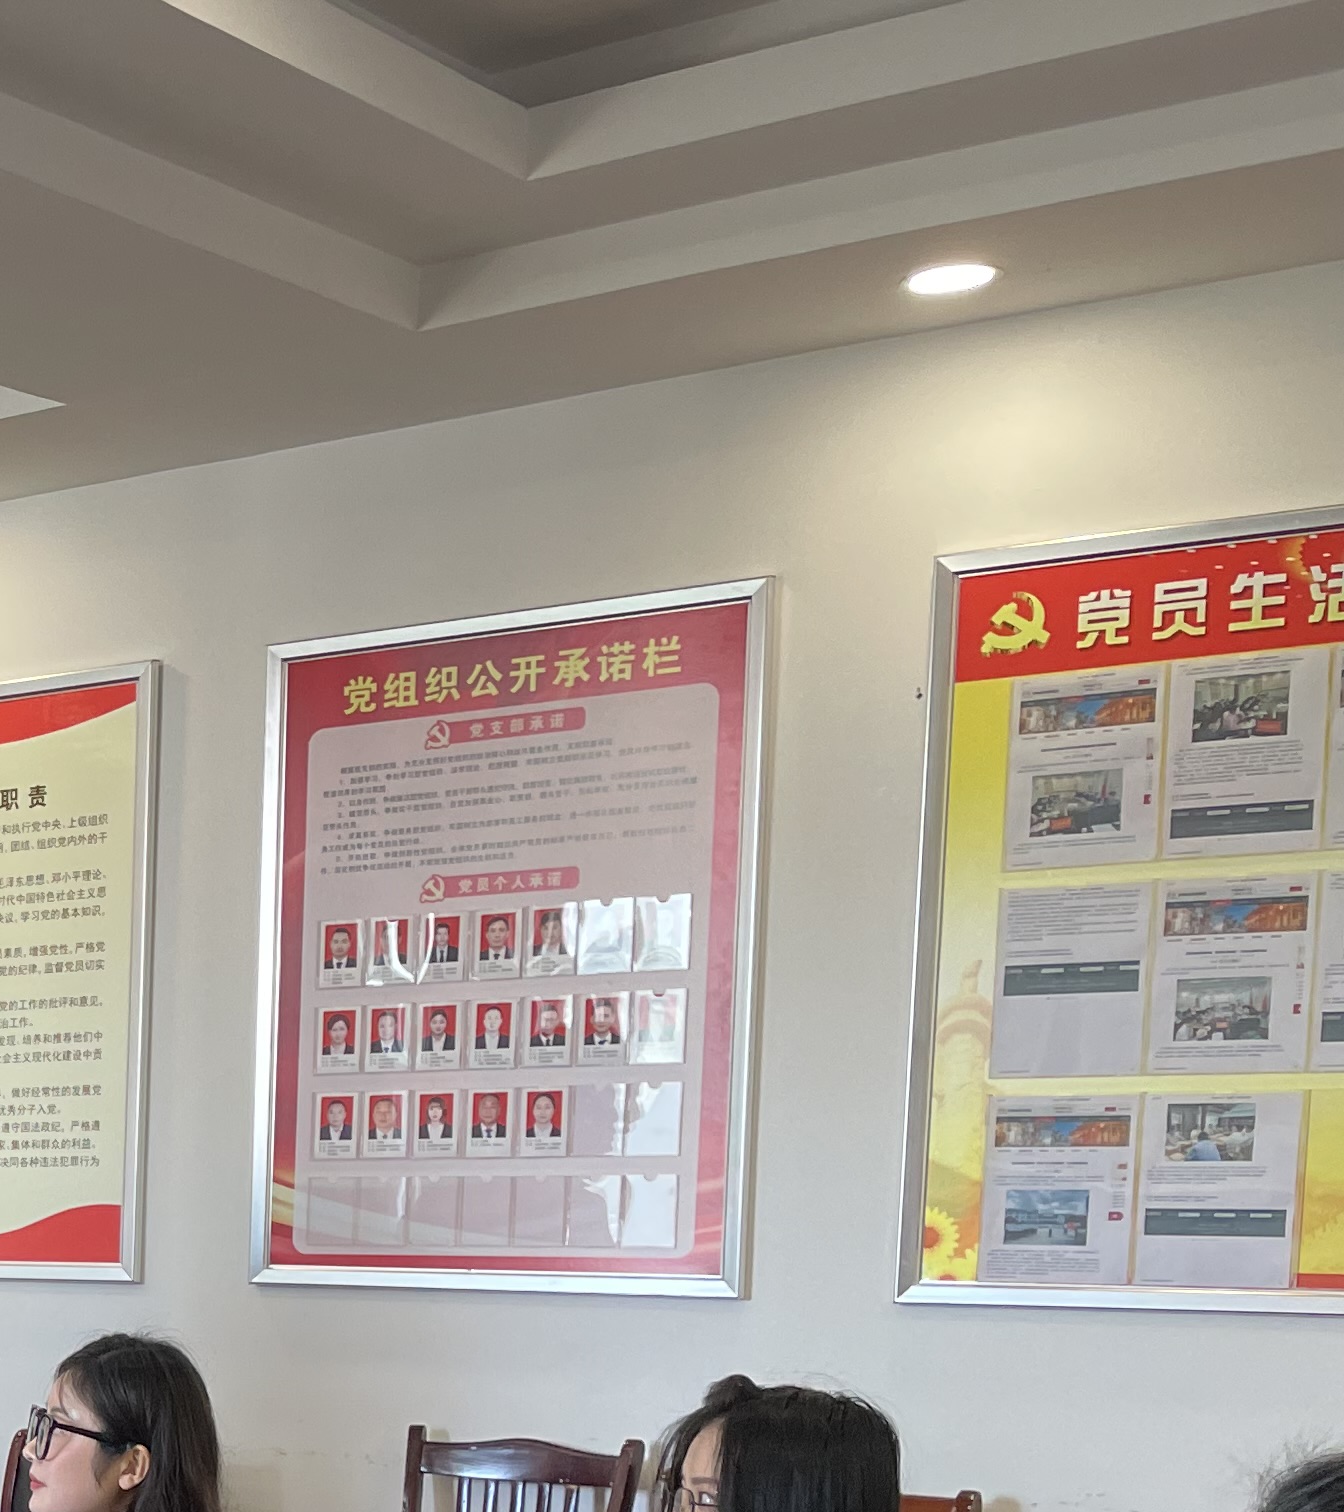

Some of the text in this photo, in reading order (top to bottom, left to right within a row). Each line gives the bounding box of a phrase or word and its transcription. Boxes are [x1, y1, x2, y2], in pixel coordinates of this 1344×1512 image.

[343, 635, 683, 716] 党组织公开承诺栏
[469, 713, 565, 738] 党支部承诺
